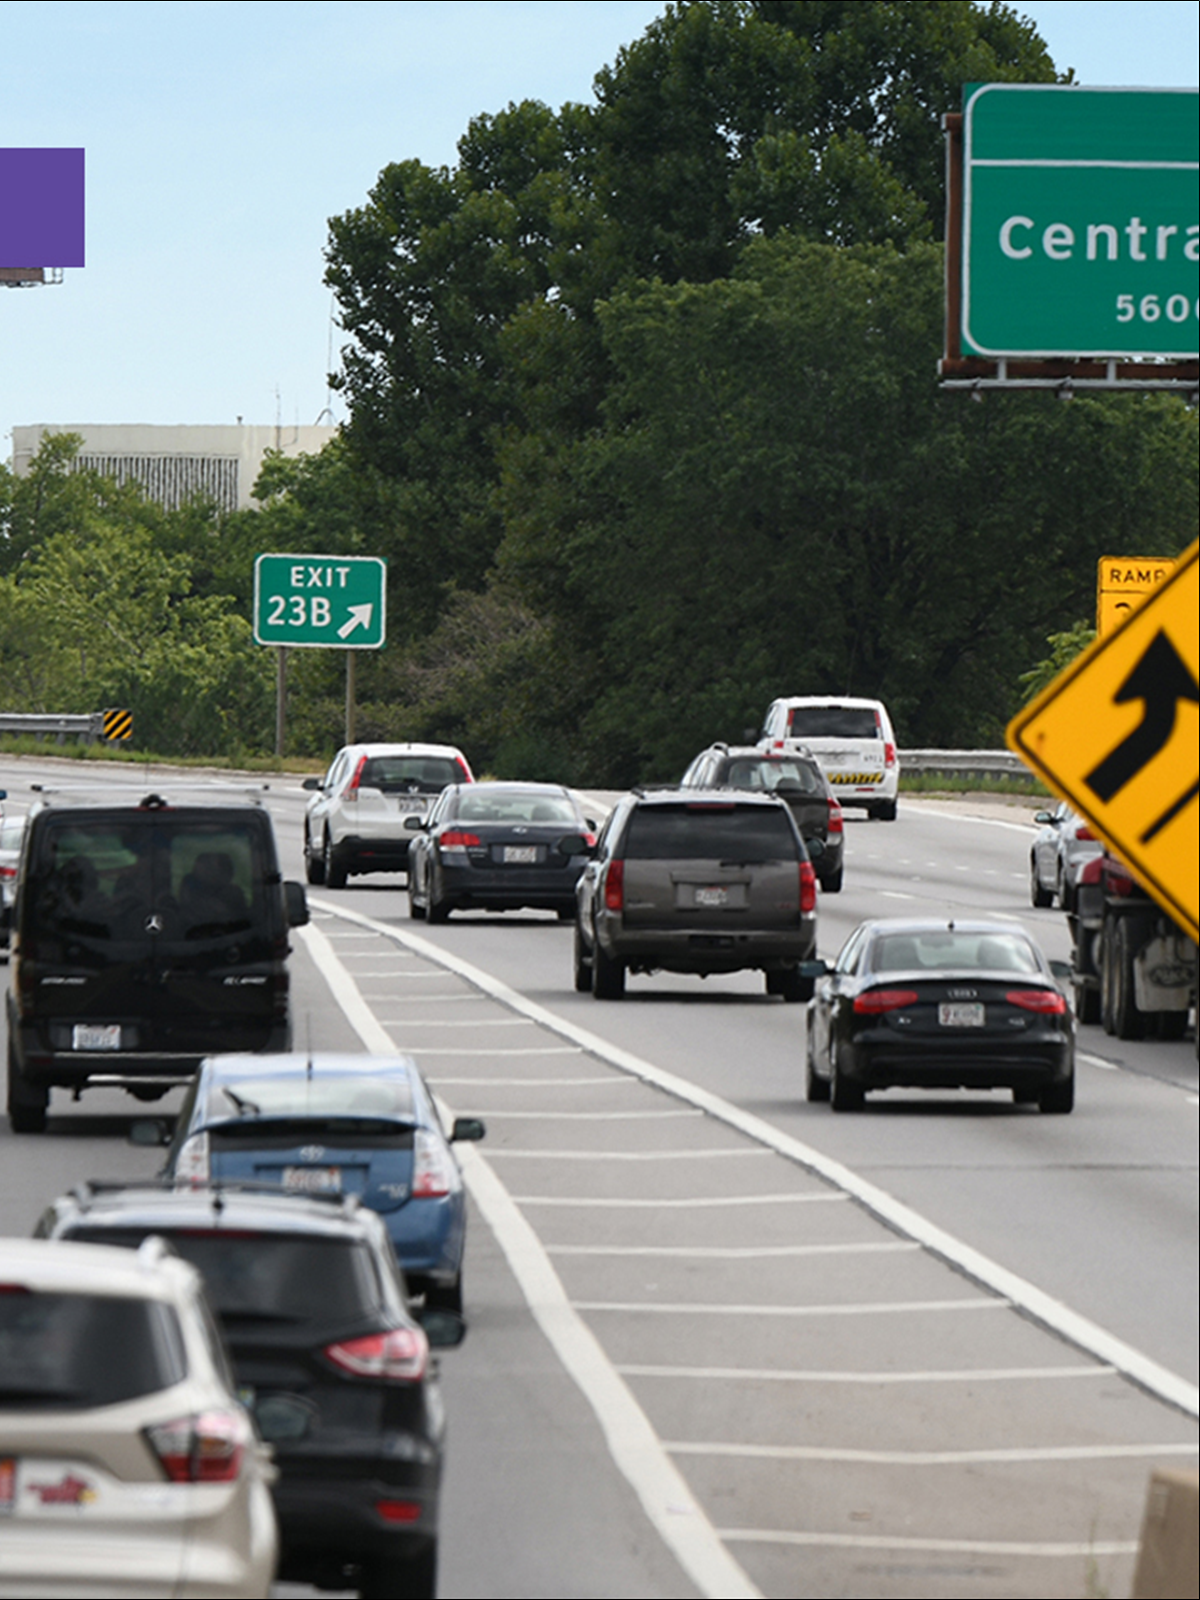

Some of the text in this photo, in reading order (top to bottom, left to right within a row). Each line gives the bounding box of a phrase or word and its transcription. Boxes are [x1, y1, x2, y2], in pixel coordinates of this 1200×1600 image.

[1115, 294, 1199, 322] 560
[291, 566, 351, 588] EXIT
[1109, 568, 1166, 584] RAMP
[267, 594, 332, 628] 23B
